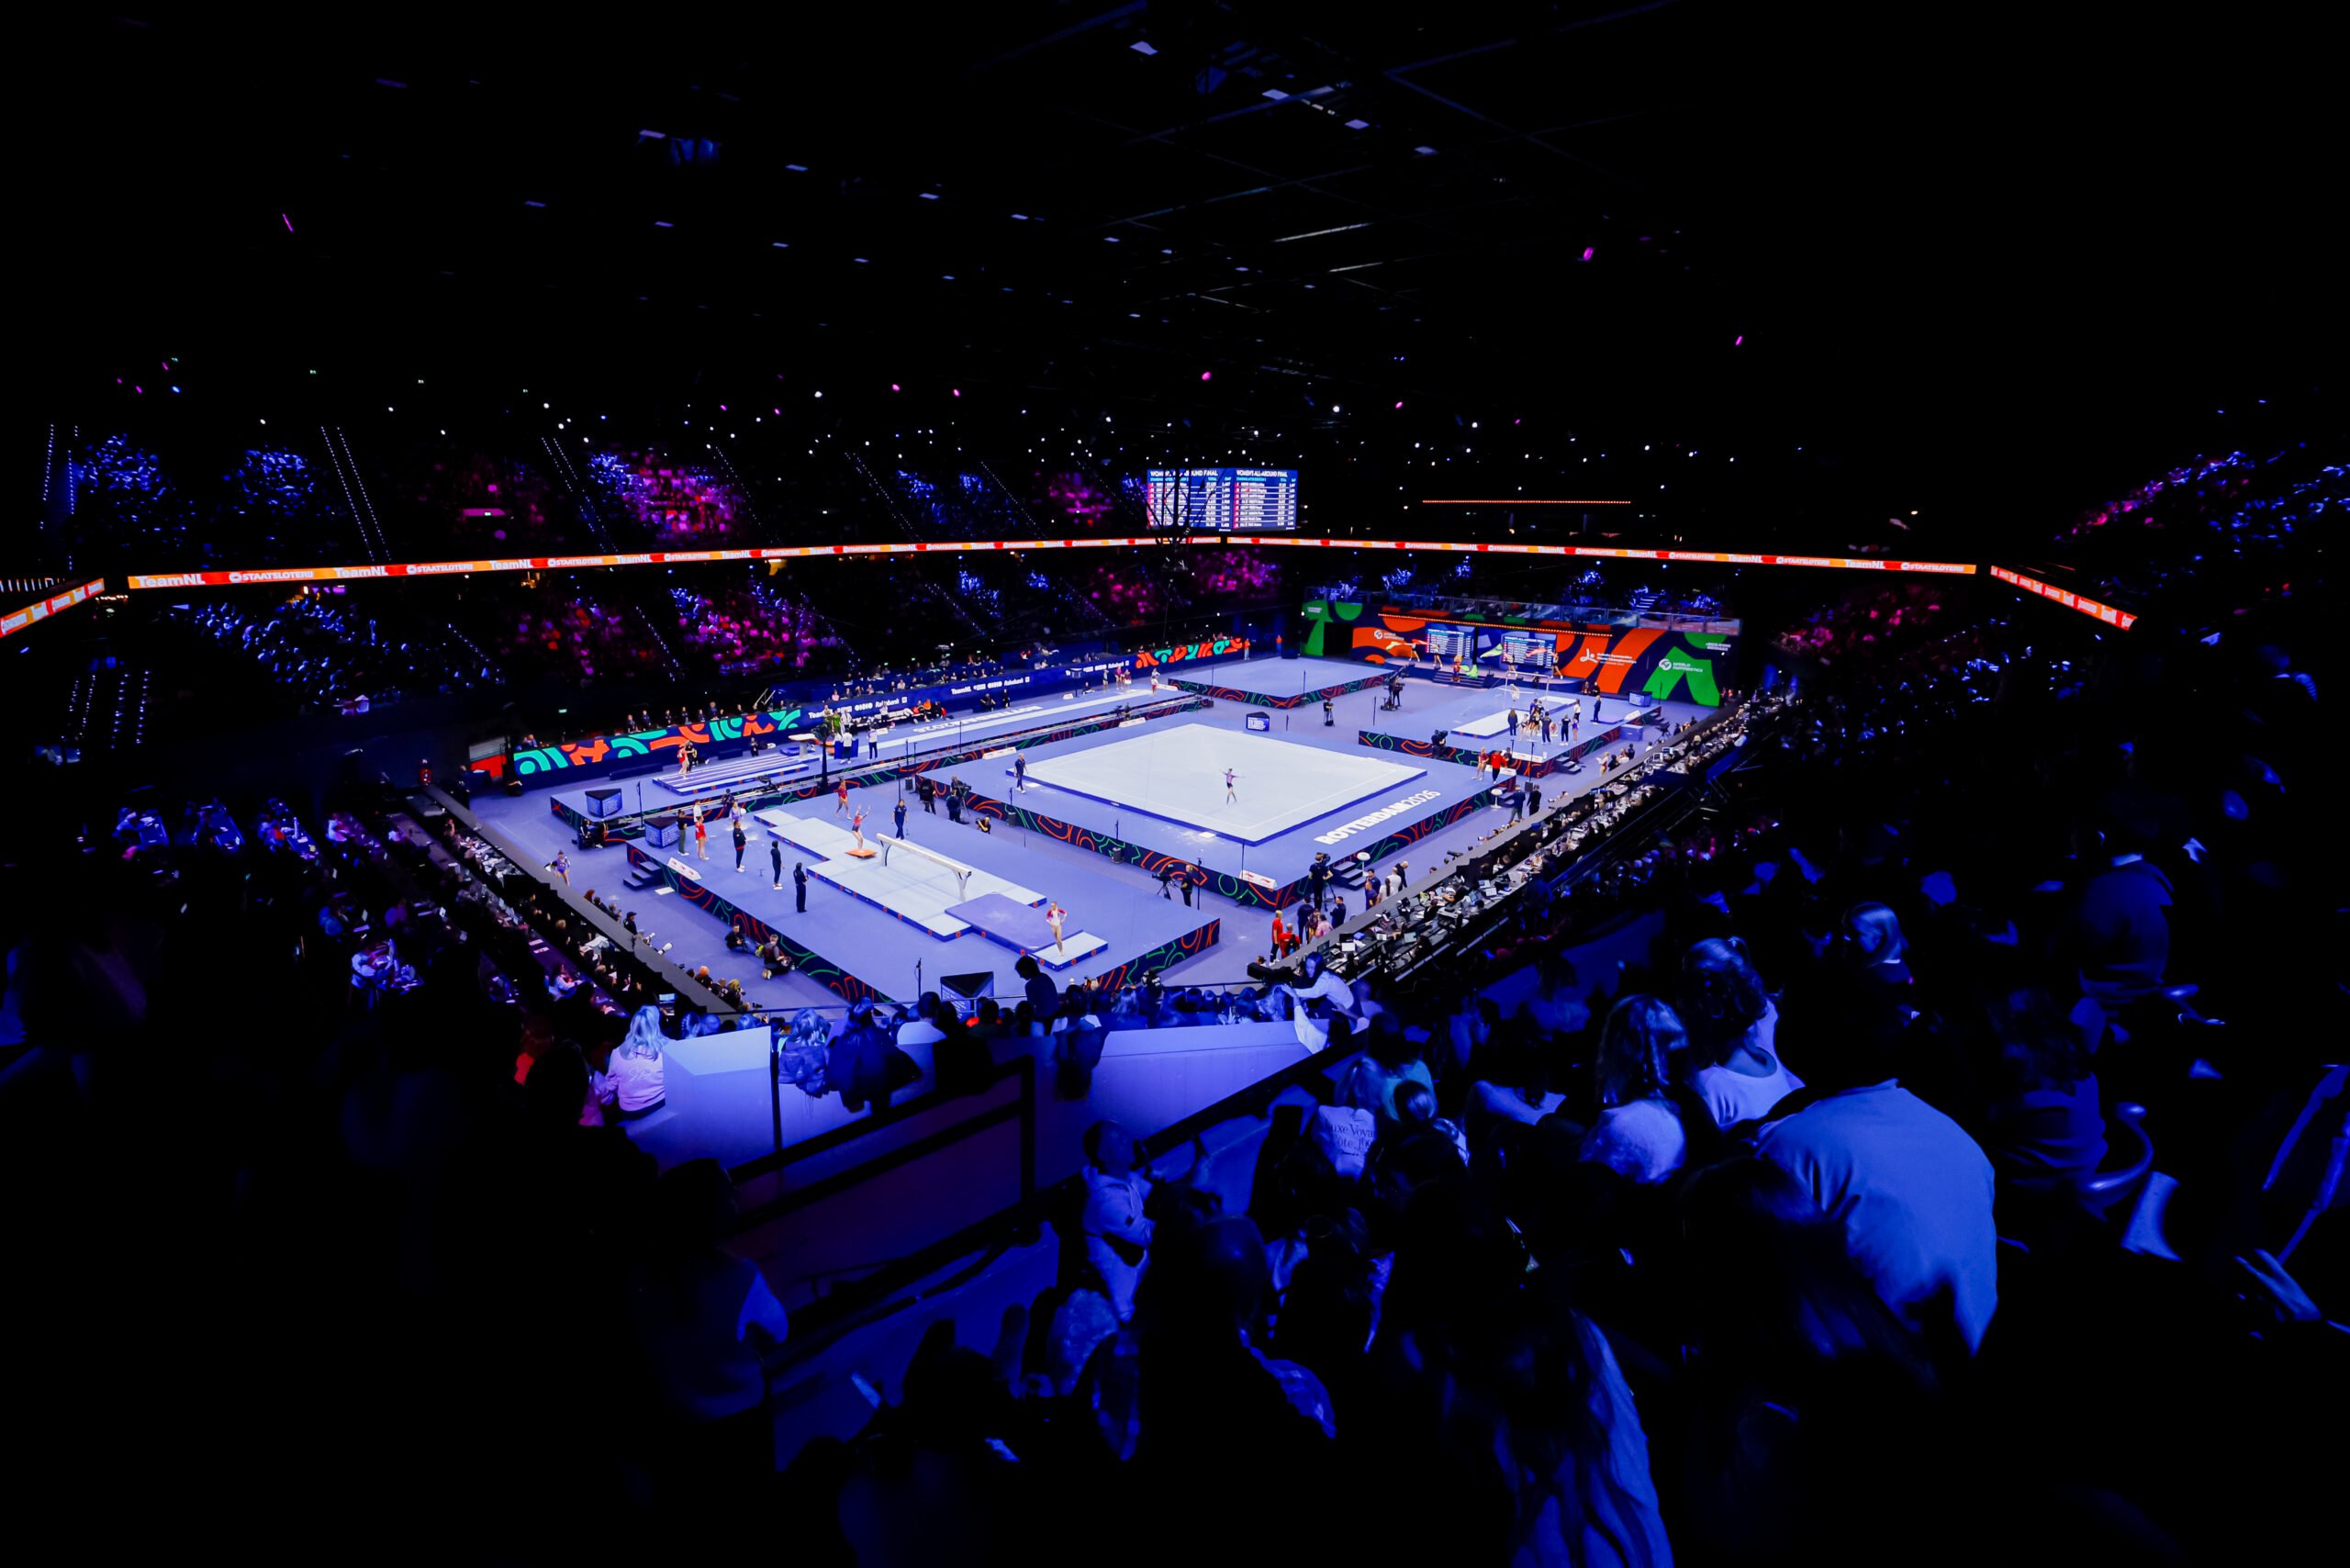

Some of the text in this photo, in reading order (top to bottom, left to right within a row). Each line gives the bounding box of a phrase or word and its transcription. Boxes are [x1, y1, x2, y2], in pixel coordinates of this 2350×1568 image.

[135, 573, 206, 588] TeamNL
[333, 566, 389, 578] TeamNL
[489, 559, 533, 570] TeamNL
[616, 554, 654, 564] TeamNL
[1727, 554, 1763, 564] TeamNL
[1844, 559, 1886, 569] TeamNL
